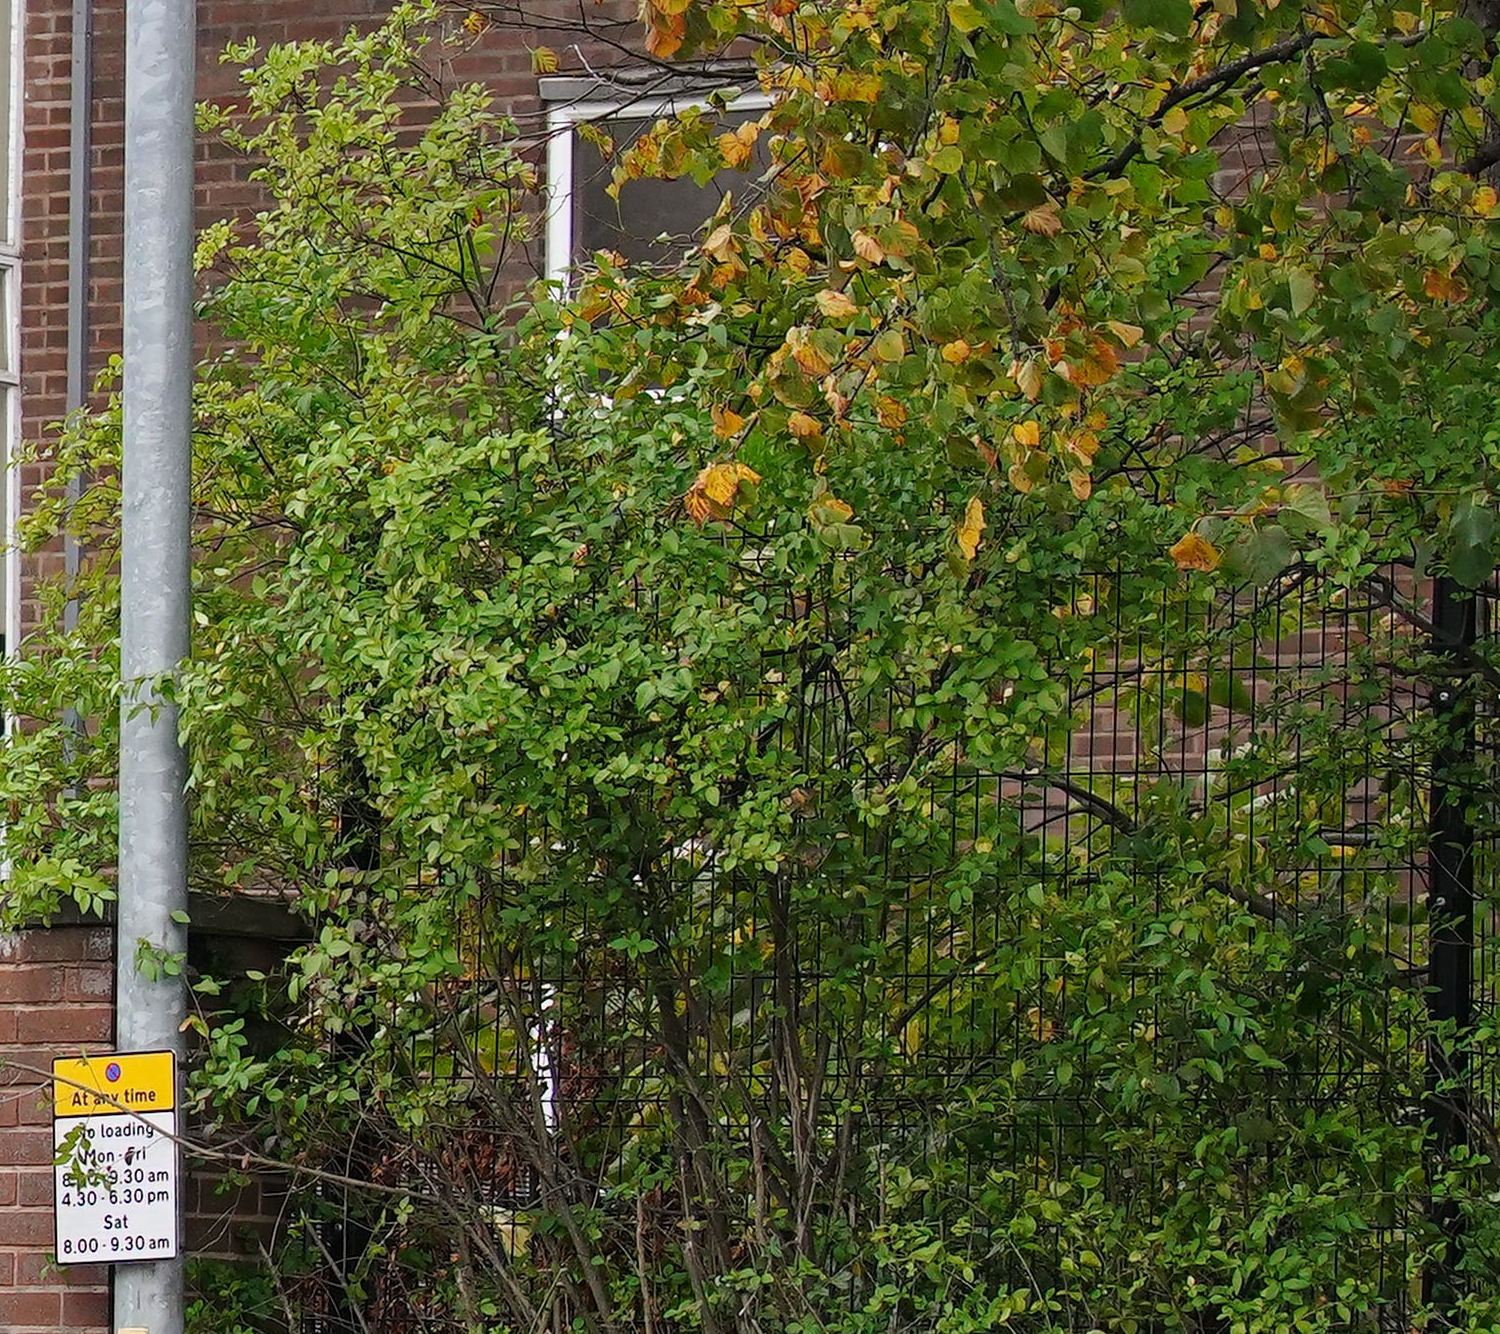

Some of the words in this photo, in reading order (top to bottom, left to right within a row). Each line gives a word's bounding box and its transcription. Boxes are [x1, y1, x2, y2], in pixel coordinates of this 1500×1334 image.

[71, 1092, 89, 1107] At
[124, 1088, 156, 1103] time
[101, 1122, 154, 1139] loading
[84, 1149, 114, 1163] Mon
[109, 1168, 144, 1185] 9.30
[147, 1170, 169, 1183] am
[61, 1191, 97, 1207] 4.30
[109, 1188, 144, 1204] 6.30
[147, 1190, 169, 1205] pm
[103, 1214, 129, 1230] Sat
[63, 1238, 99, 1254] 8.00
[110, 1235, 145, 1251] 9.30
[148, 1237, 170, 1250] am
